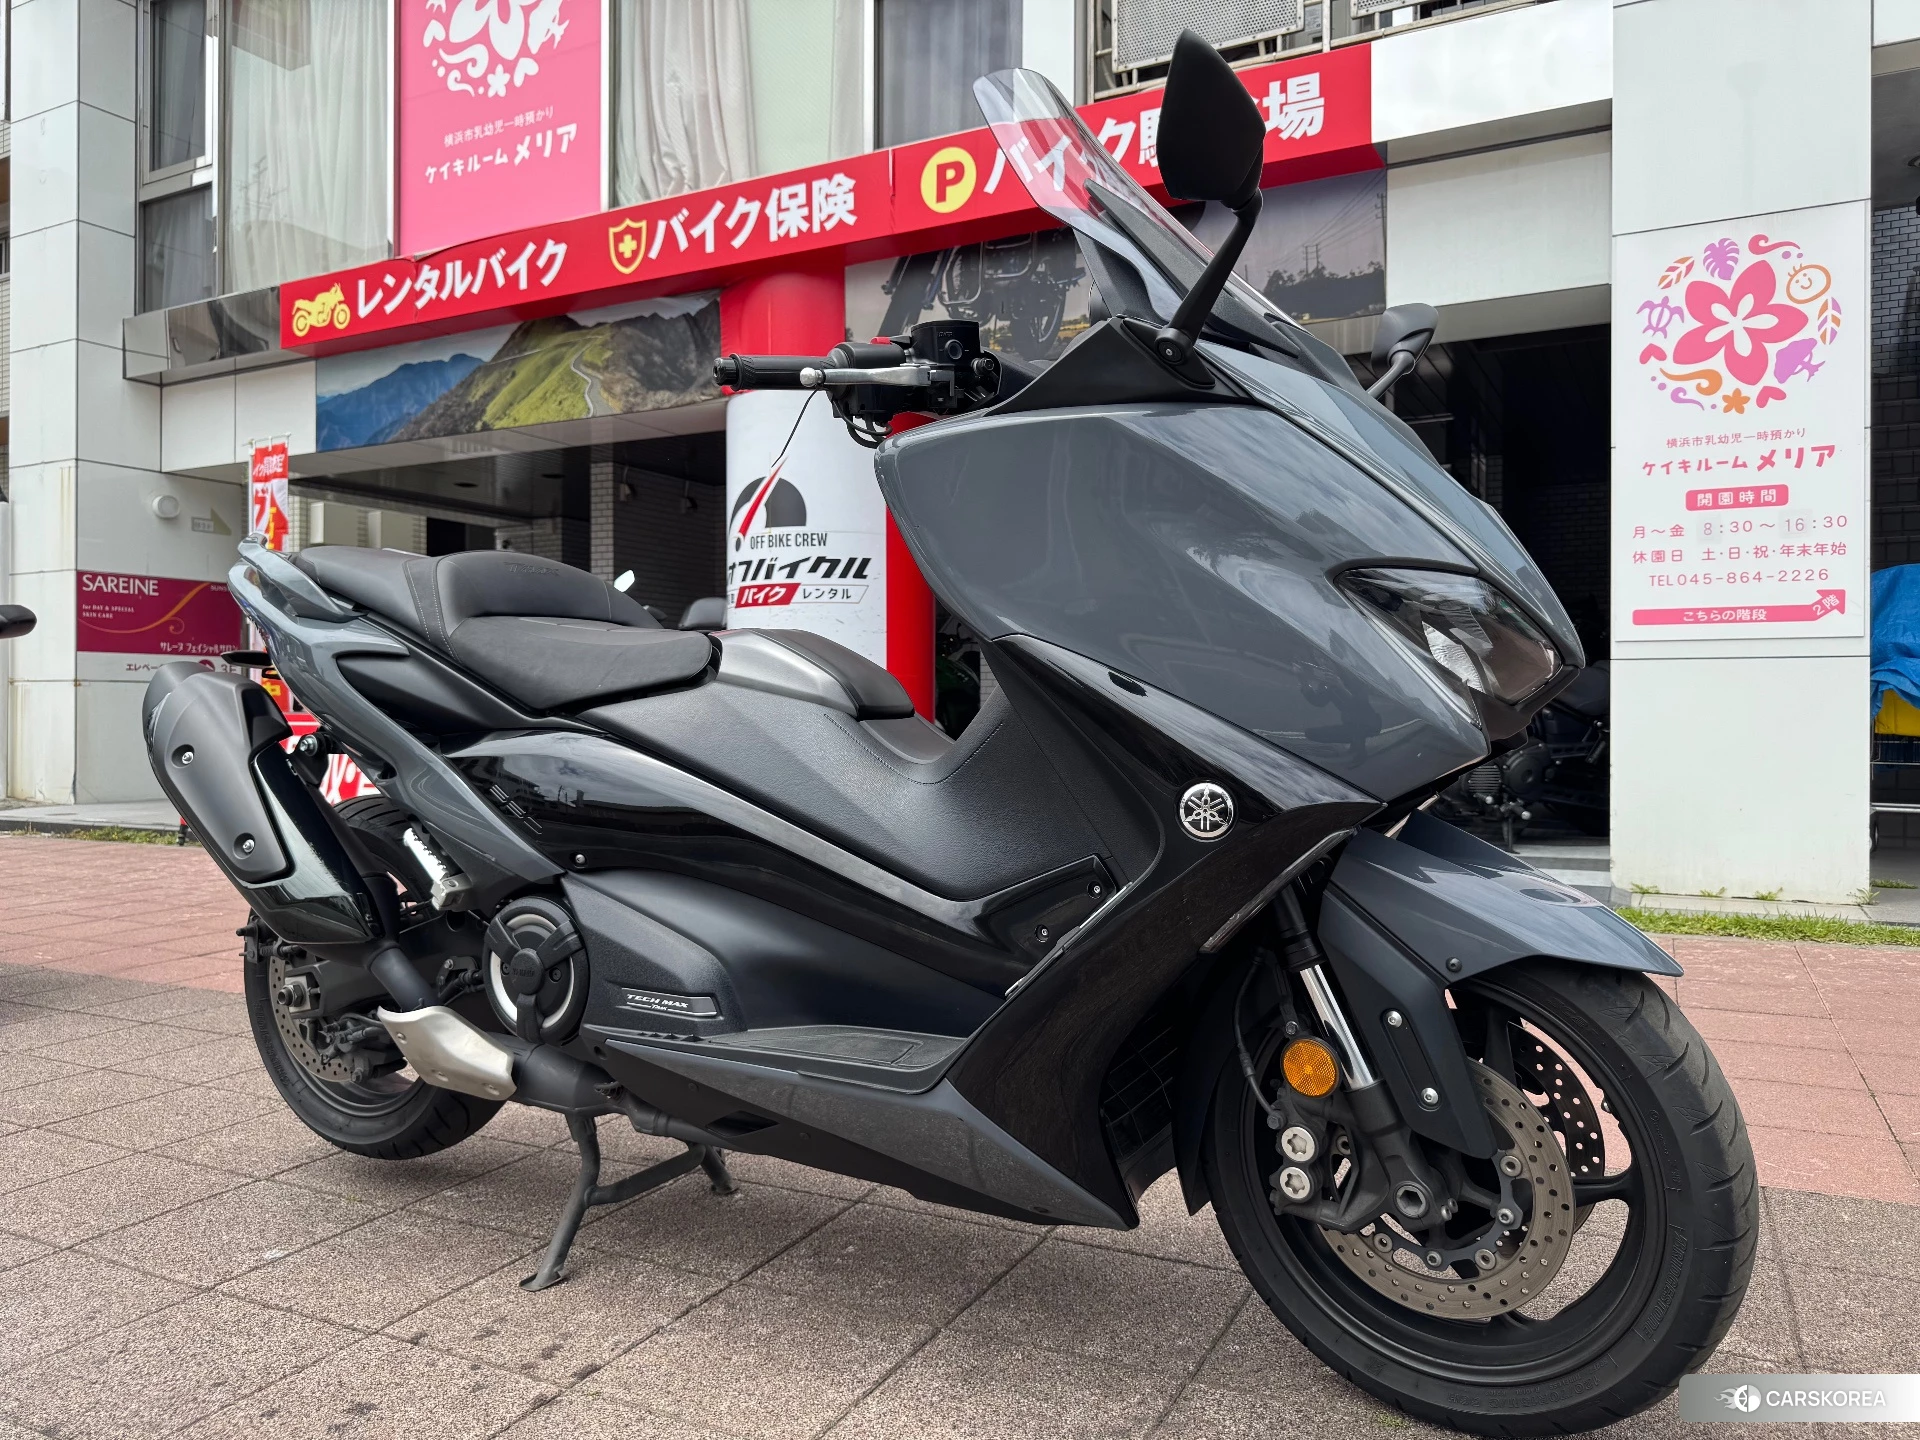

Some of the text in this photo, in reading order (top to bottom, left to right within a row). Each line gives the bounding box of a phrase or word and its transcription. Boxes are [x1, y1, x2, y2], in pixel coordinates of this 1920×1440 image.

[444, 106, 554, 148] 横浜市乳幼児一時預かり
[983, 72, 1325, 194] バイク場
[425, 123, 577, 184] ケイキルーム メリア
[647, 172, 858, 261] バイク保険
[357, 238, 569, 319] レンタルバイク
[1666, 428, 1806, 449] 横浜市乳幼児一時預かり
[1642, 445, 1836, 476] ケイキルーム メリア
[1696, 488, 1777, 507] 開園時間
[750, 532, 828, 550] OFF BIKE CREW
[1632, 549, 1684, 564] 休園日
[82, 574, 160, 597] SAREINE
[740, 586, 788, 605] バイク
[802, 587, 853, 600] レンタル
[111, 605, 135, 613] SPECIAL
[1683, 608, 1768, 622] こちらの階段
[1812, 593, 1840, 616] 2階
[82, 611, 114, 620] SKIN CARE
[626, 993, 689, 1009] TECH MAX
